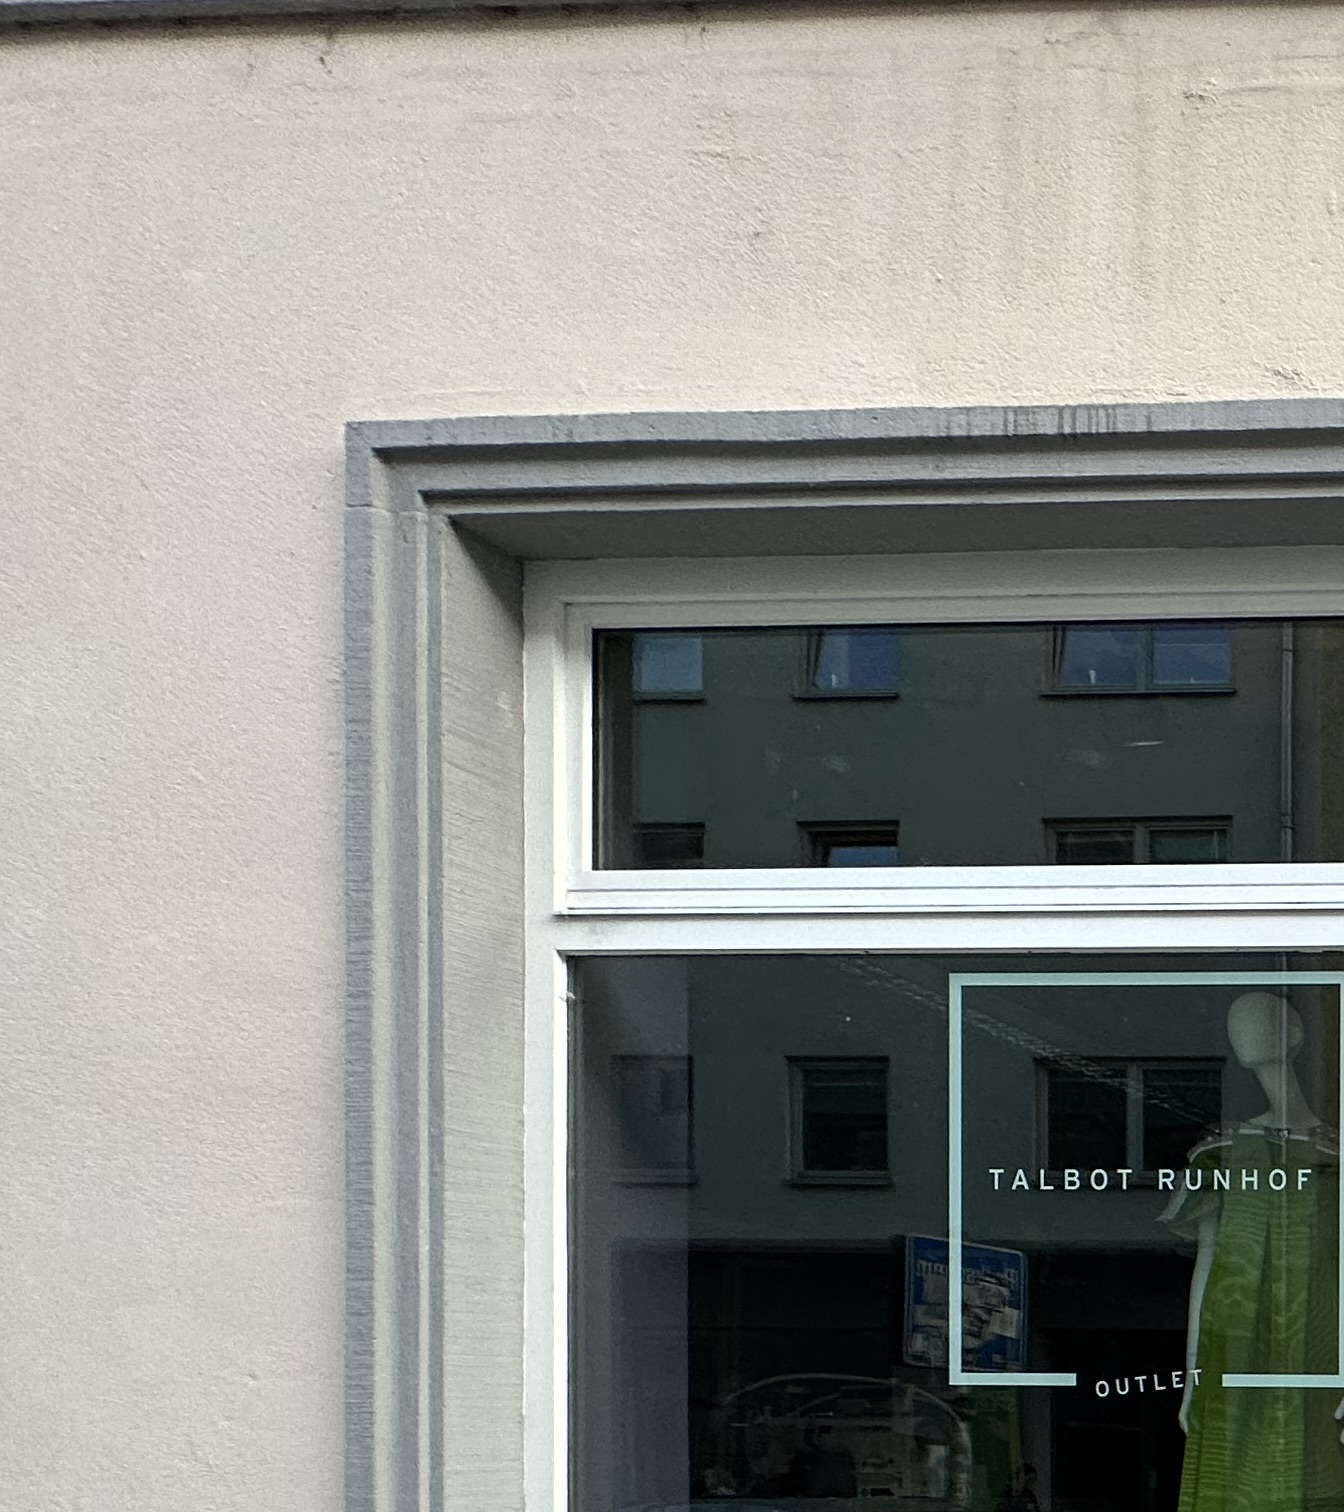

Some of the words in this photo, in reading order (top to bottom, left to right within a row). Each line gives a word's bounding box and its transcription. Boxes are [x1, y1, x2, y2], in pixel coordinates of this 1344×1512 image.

[989, 1168, 1134, 1191] TALBOT
[1158, 1168, 1313, 1191] RUNHOF
[1094, 1369, 1202, 1398] OUTLET
